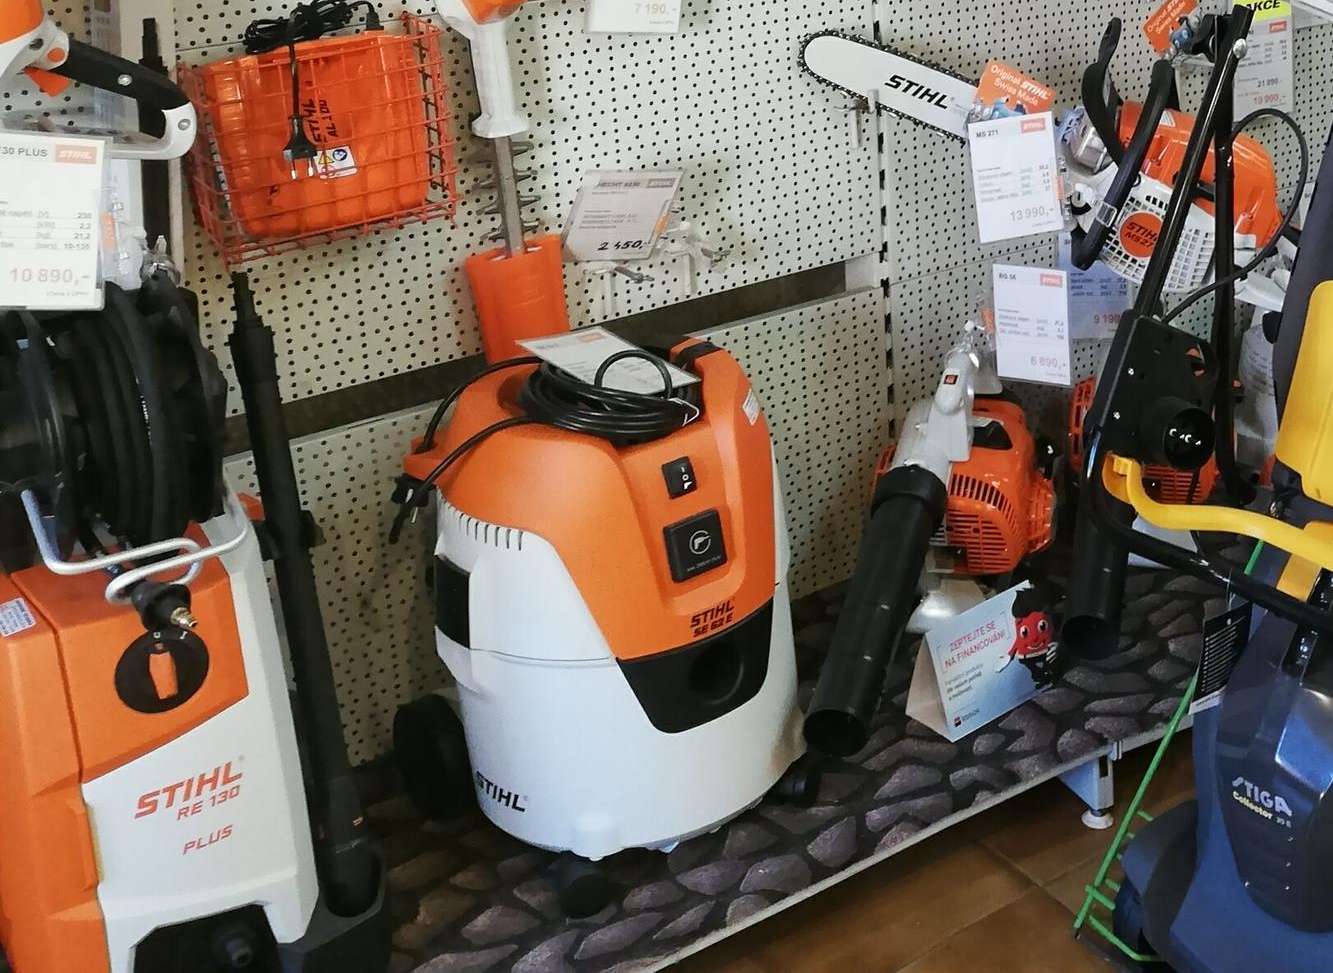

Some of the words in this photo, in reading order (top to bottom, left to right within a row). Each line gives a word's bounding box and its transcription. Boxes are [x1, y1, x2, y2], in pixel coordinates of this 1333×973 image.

[884, 73, 949, 110] STIHL
[990, 64, 1021, 86] Original
[1020, 81, 1049, 100] STIHL
[993, 77, 1017, 95] Swiss
[1017, 88, 1039, 106] Made
[18, 147, 48, 157] PLUS
[59, 150, 93, 160] STIHL
[1009, 210, 1023, 221] 13
[597, 242, 609, 251] 2
[1125, 222, 1161, 242] STIH
[10, 267, 32, 282] 10
[38, 269, 90, 286] 890,-
[691, 599, 734, 628] STIHL
[693, 625, 709, 638] SE
[949, 626, 986, 652] ZEPTEJTE
[986, 620, 997, 632] SE
[944, 657, 957, 669] NA
[957, 630, 1006, 663] FINANCOVÁNÍ
[133, 761, 244, 820] STIHL
[176, 801, 206, 821] RE
[210, 784, 241, 807] 130
[476, 771, 526, 813] STIHL
[1231, 776, 1293, 817] STIGA
[1232, 790, 1273, 820] Collector
[182, 825, 233, 856] PLUS
